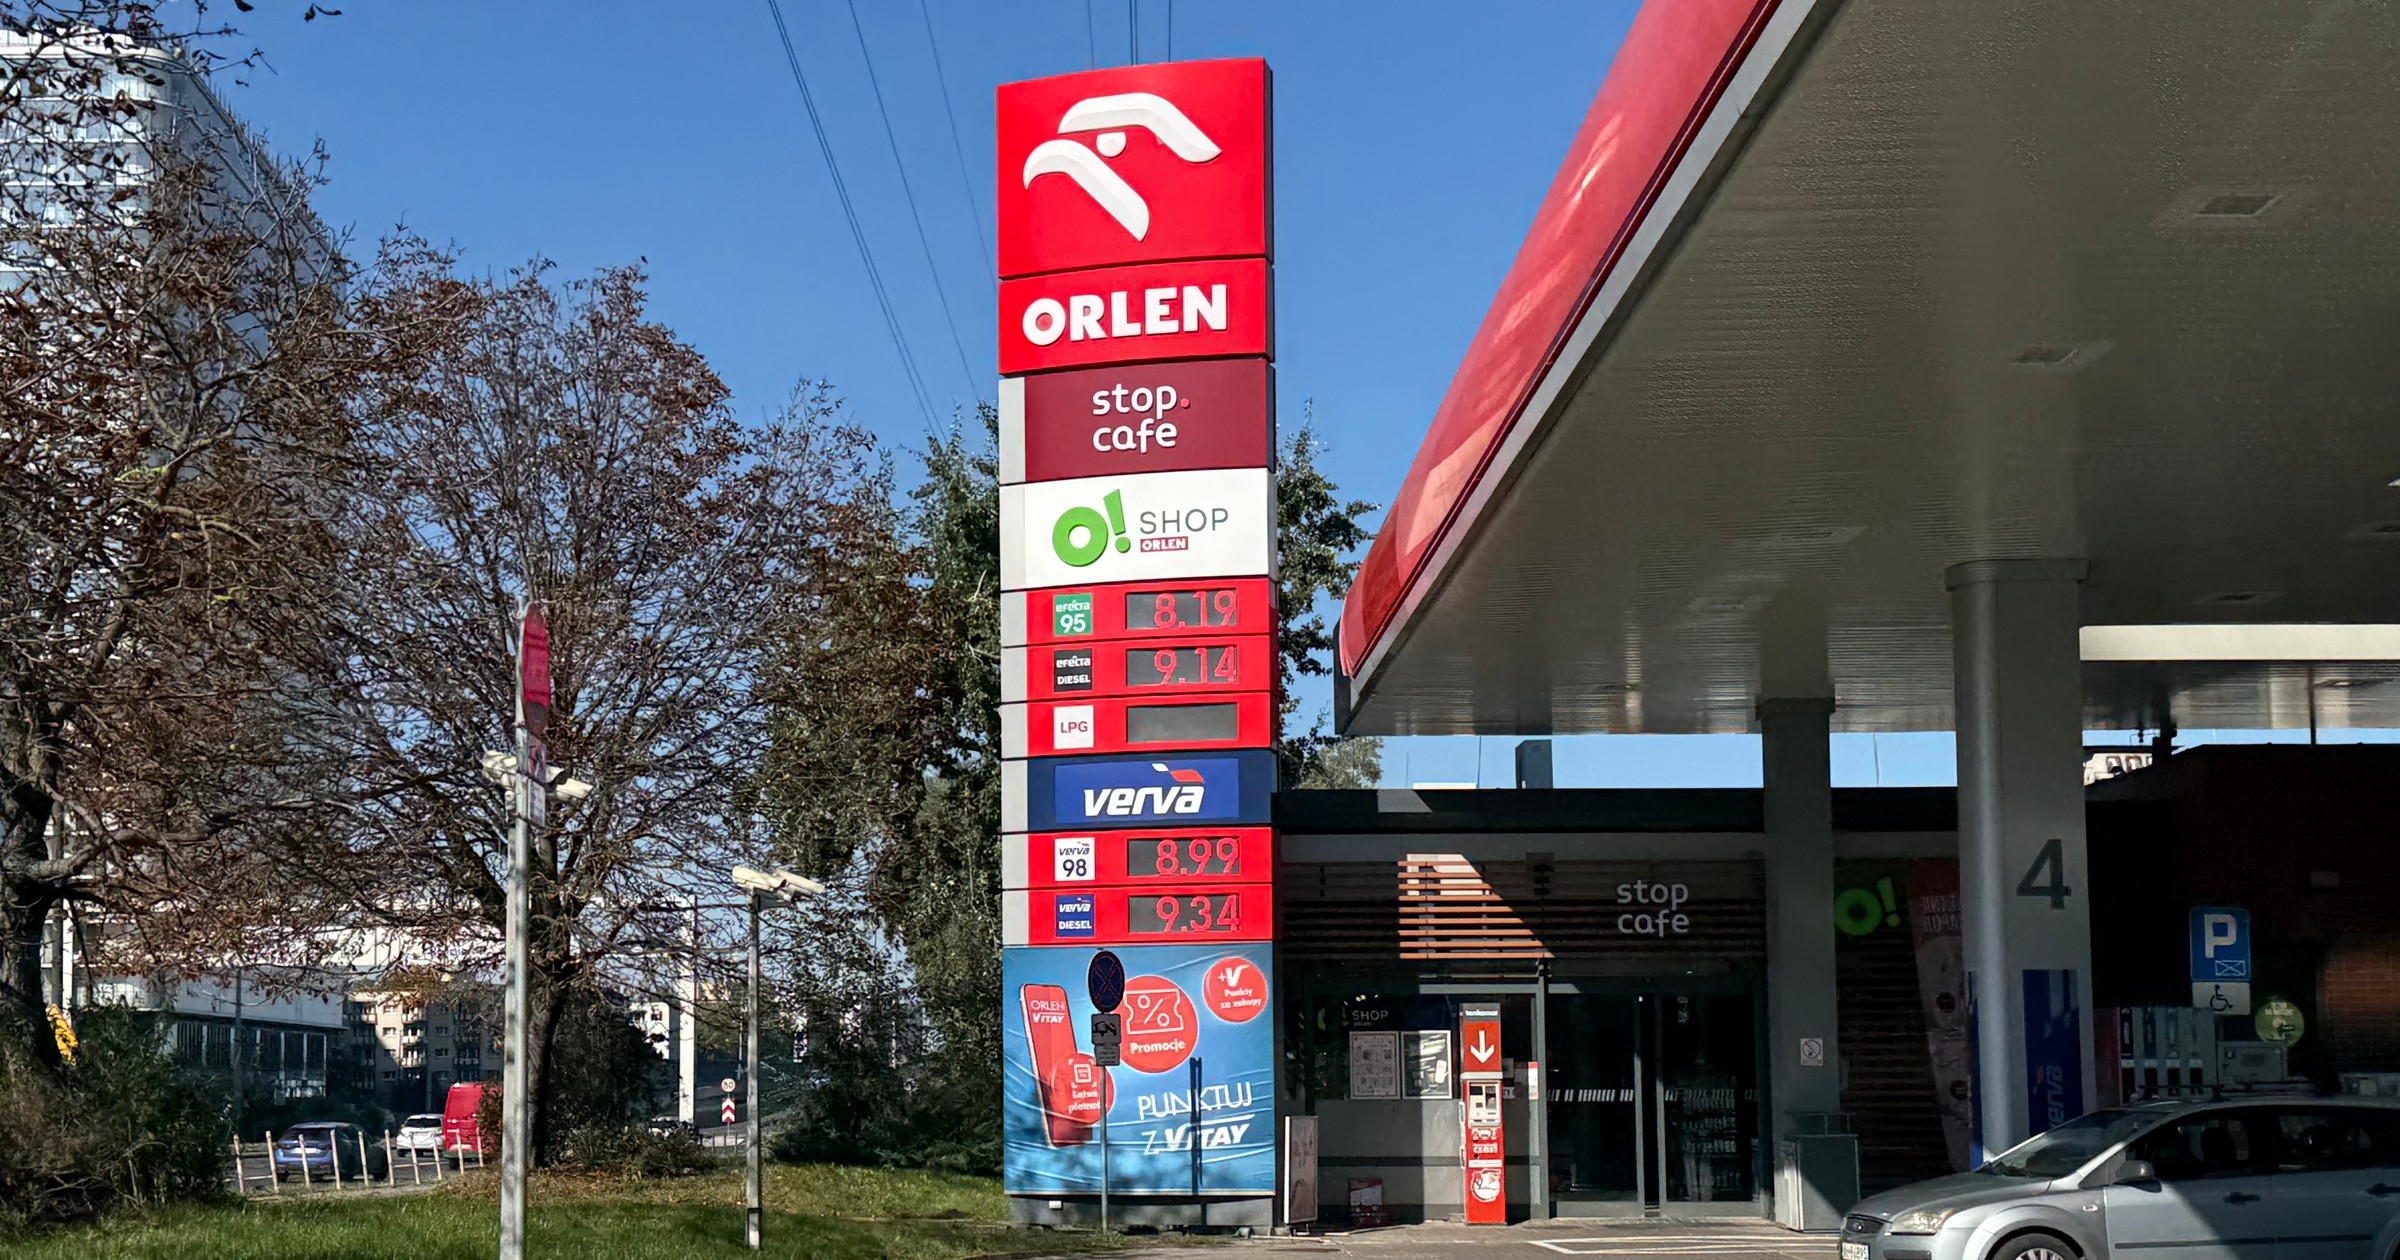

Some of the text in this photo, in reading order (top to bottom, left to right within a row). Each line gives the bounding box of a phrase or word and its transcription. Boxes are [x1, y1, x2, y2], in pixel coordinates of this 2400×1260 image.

[1022, 284, 1228, 346] ORLEN
[1092, 418, 1178, 454] cafe
[1139, 508, 1229, 535] SHOP
[1141, 537, 1187, 551] ORLEN
[1154, 589, 1237, 629] 8.19
[1060, 614, 1087, 633] 95
[1057, 674, 1091, 685] DIESEL
[1154, 646, 1237, 685] 9.14
[1060, 721, 1089, 734] LPG
[1083, 785, 1205, 817] verva
[1059, 847, 1090, 856] verva
[1156, 837, 1239, 876] 8.99
[1062, 858, 1087, 877] 98
[2016, 838, 2072, 910] 4
[1059, 903, 1091, 912] verva
[1616, 879, 1689, 910] stop
[1058, 920, 1092, 930] DIESEL
[1156, 895, 1240, 932] 9.34
[1617, 909, 1690, 938] cafe
[2204, 912, 2238, 959] P
[1030, 999, 1065, 1011] ORLEN
[1351, 1009, 1389, 1021] SHOP
[1130, 1038, 1186, 1055] Promocje
[1138, 1082, 1253, 1120] PUNKTUJ
